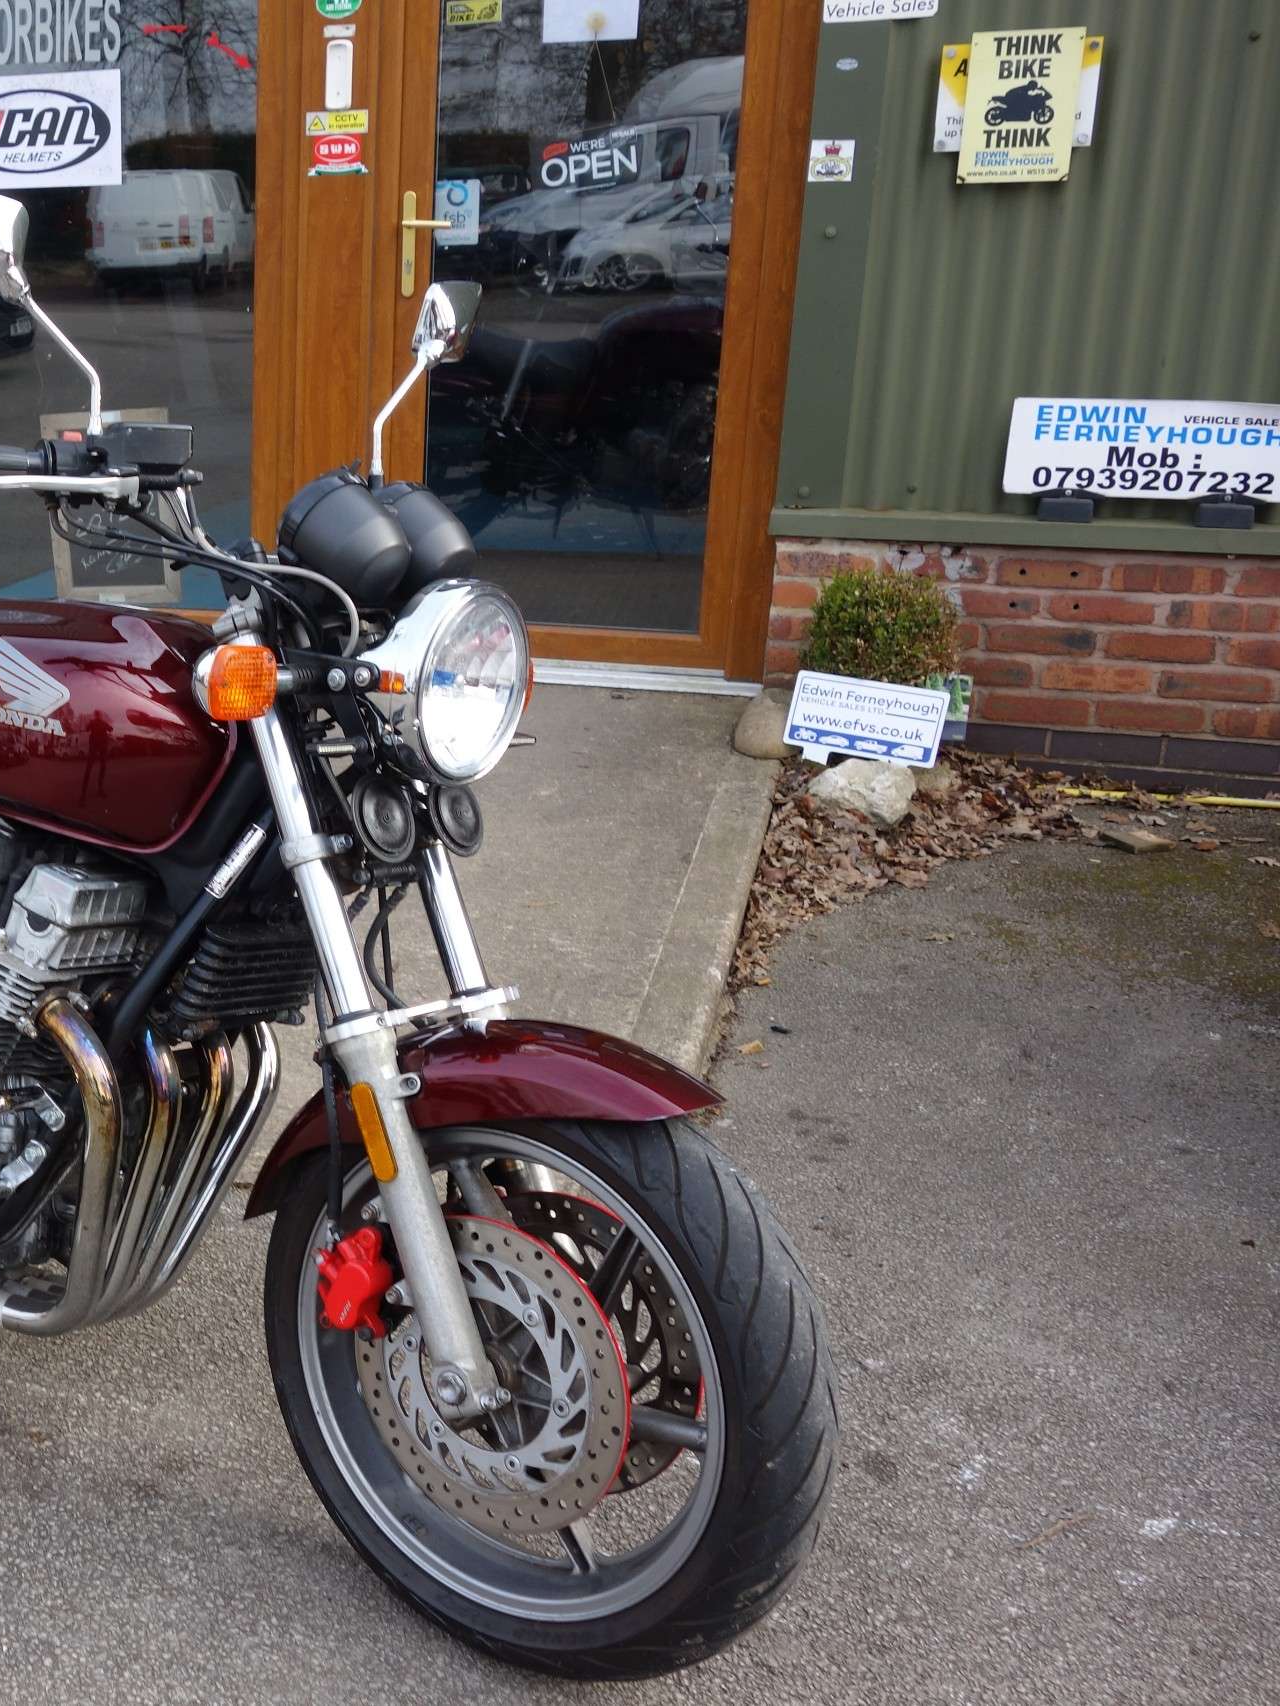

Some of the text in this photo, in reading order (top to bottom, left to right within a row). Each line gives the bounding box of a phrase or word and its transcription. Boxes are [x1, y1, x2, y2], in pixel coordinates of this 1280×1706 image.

[826, 0, 935, 18] Vehicle Sales
[993, 34, 1063, 57] THINK
[997, 58, 1052, 80] BIKE
[335, 114, 359, 123] CCTV
[570, 138, 606, 153] WE'RE
[983, 127, 1052, 149] THINK
[4, 151, 63, 164] HELMETS
[541, 144, 638, 187] OPEN
[974, 157, 1054, 167] FERNEYHOUGH
[975, 151, 1009, 160] EDWIN
[1037, 405, 1147, 424] EDWIN
[1183, 415, 1240, 425] VEHICLE
[1034, 424, 1280, 446] FERNEYHOUGH
[1106, 446, 1180, 469] Mob
[1032, 467, 1276, 495] 07939207232
[800, 695, 884, 716] VEHICLE SALES LTD
[802, 683, 940, 716] Edwin Ferneyhough
[801, 713, 924, 742] www.efvs.co.uk
